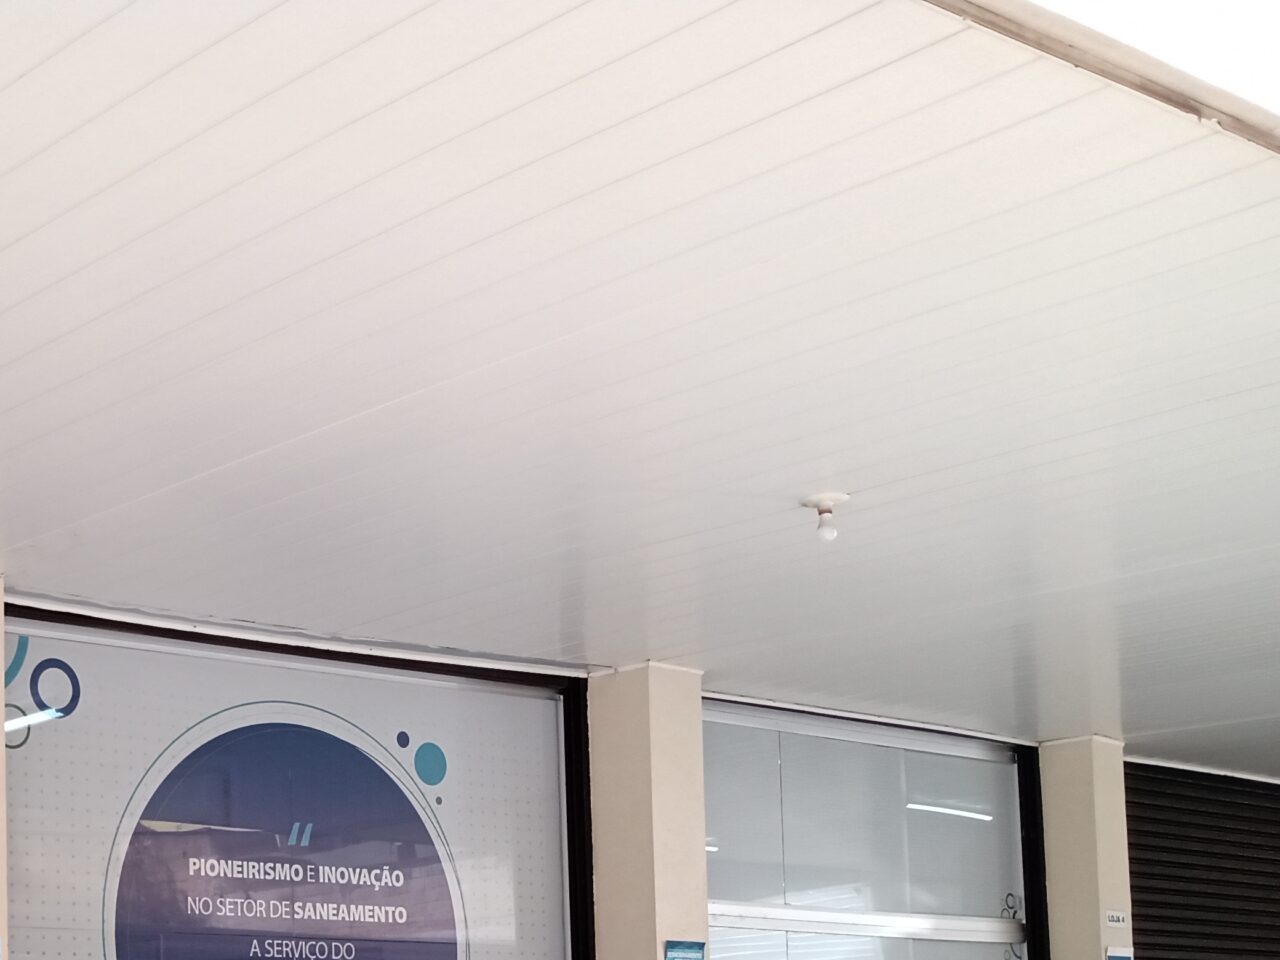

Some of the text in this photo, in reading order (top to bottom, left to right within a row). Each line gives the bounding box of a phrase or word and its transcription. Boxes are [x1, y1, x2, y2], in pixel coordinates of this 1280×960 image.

[188, 858, 404, 891] PIONEIRISMO E INOVAÇÃO
[187, 896, 407, 923] NO SETOR DE SANEAMENTO
[250, 940, 261, 957] A
[332, 942, 355, 960] DO
